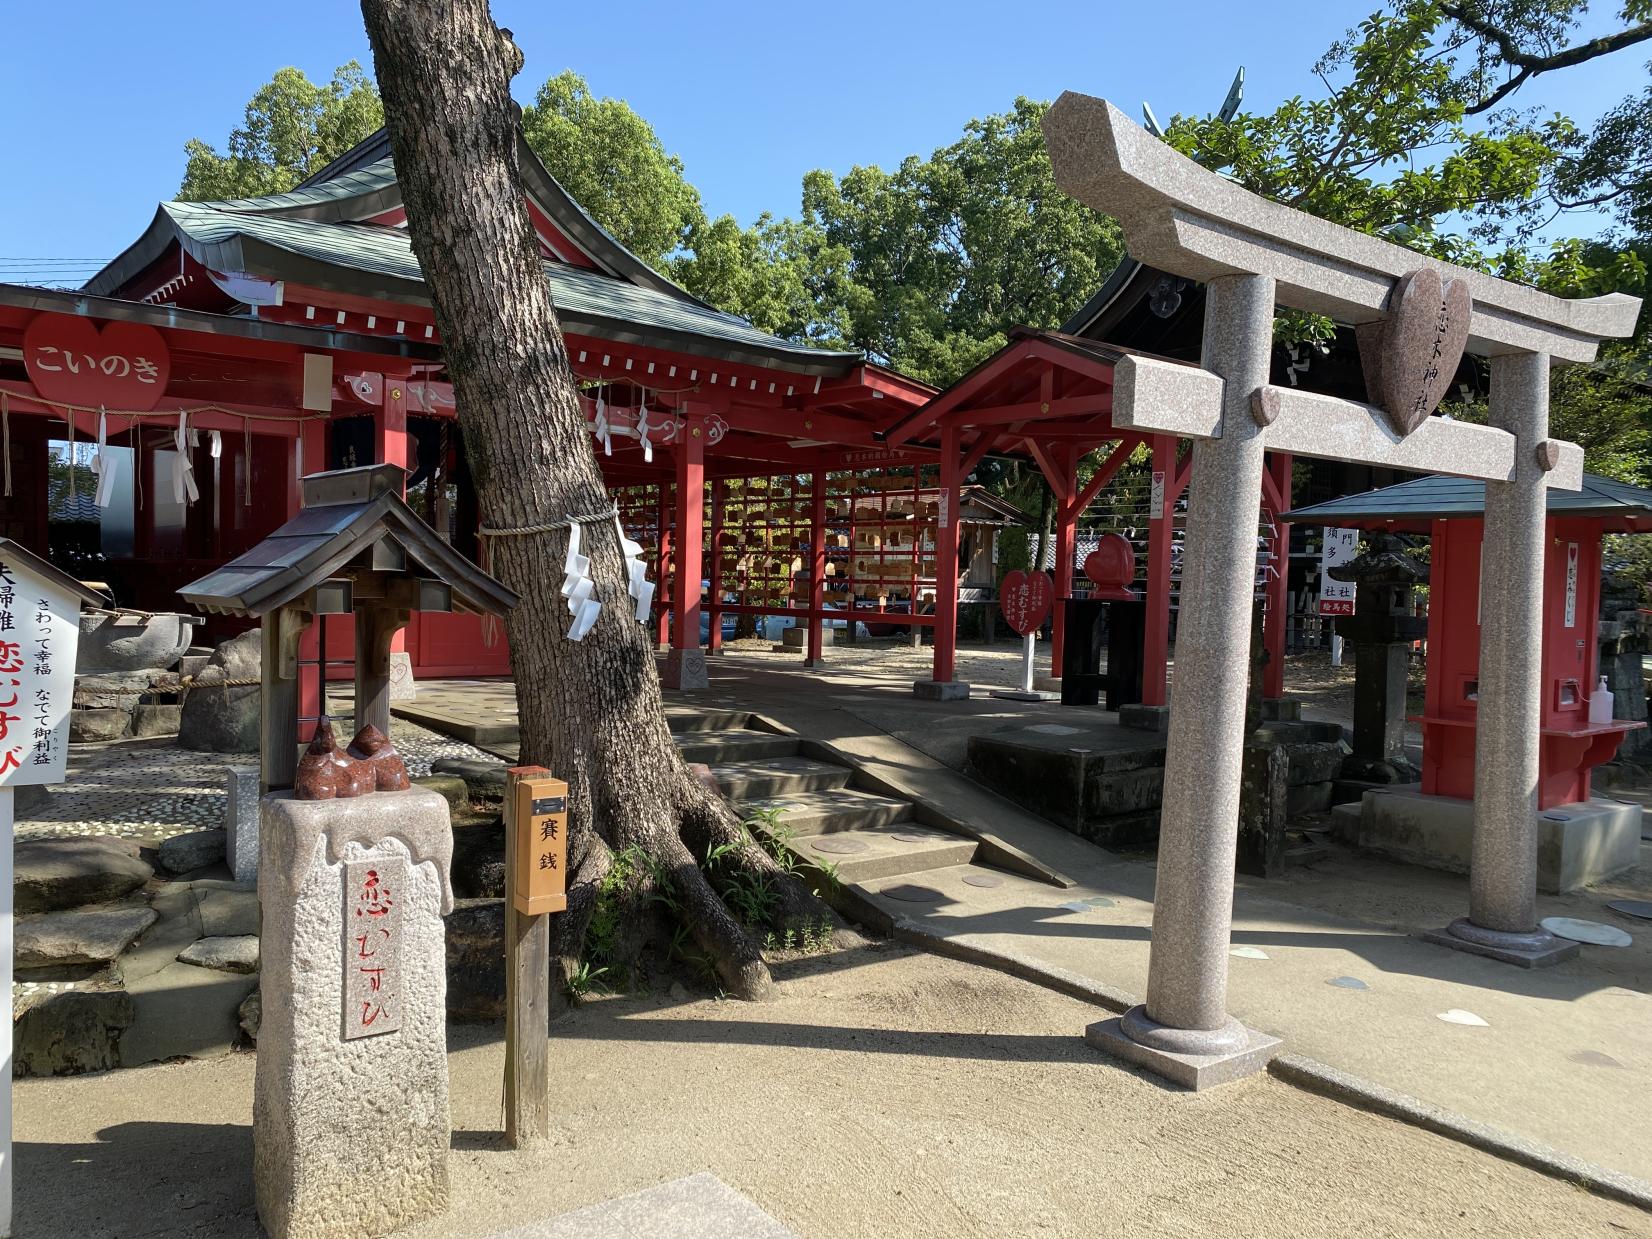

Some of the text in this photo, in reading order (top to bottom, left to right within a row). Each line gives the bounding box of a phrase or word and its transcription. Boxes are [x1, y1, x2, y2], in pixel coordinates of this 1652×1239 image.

[36, 346, 159, 384] こいのき
[1415, 300, 1448, 411] 恋木神社
[1018, 583, 1029, 631] 恋むすび
[32, 598, 52, 766] さわって幸福 なでて御利益
[539, 818, 559, 871] 賽銭
[356, 870, 393, 1026] 恋むすび
